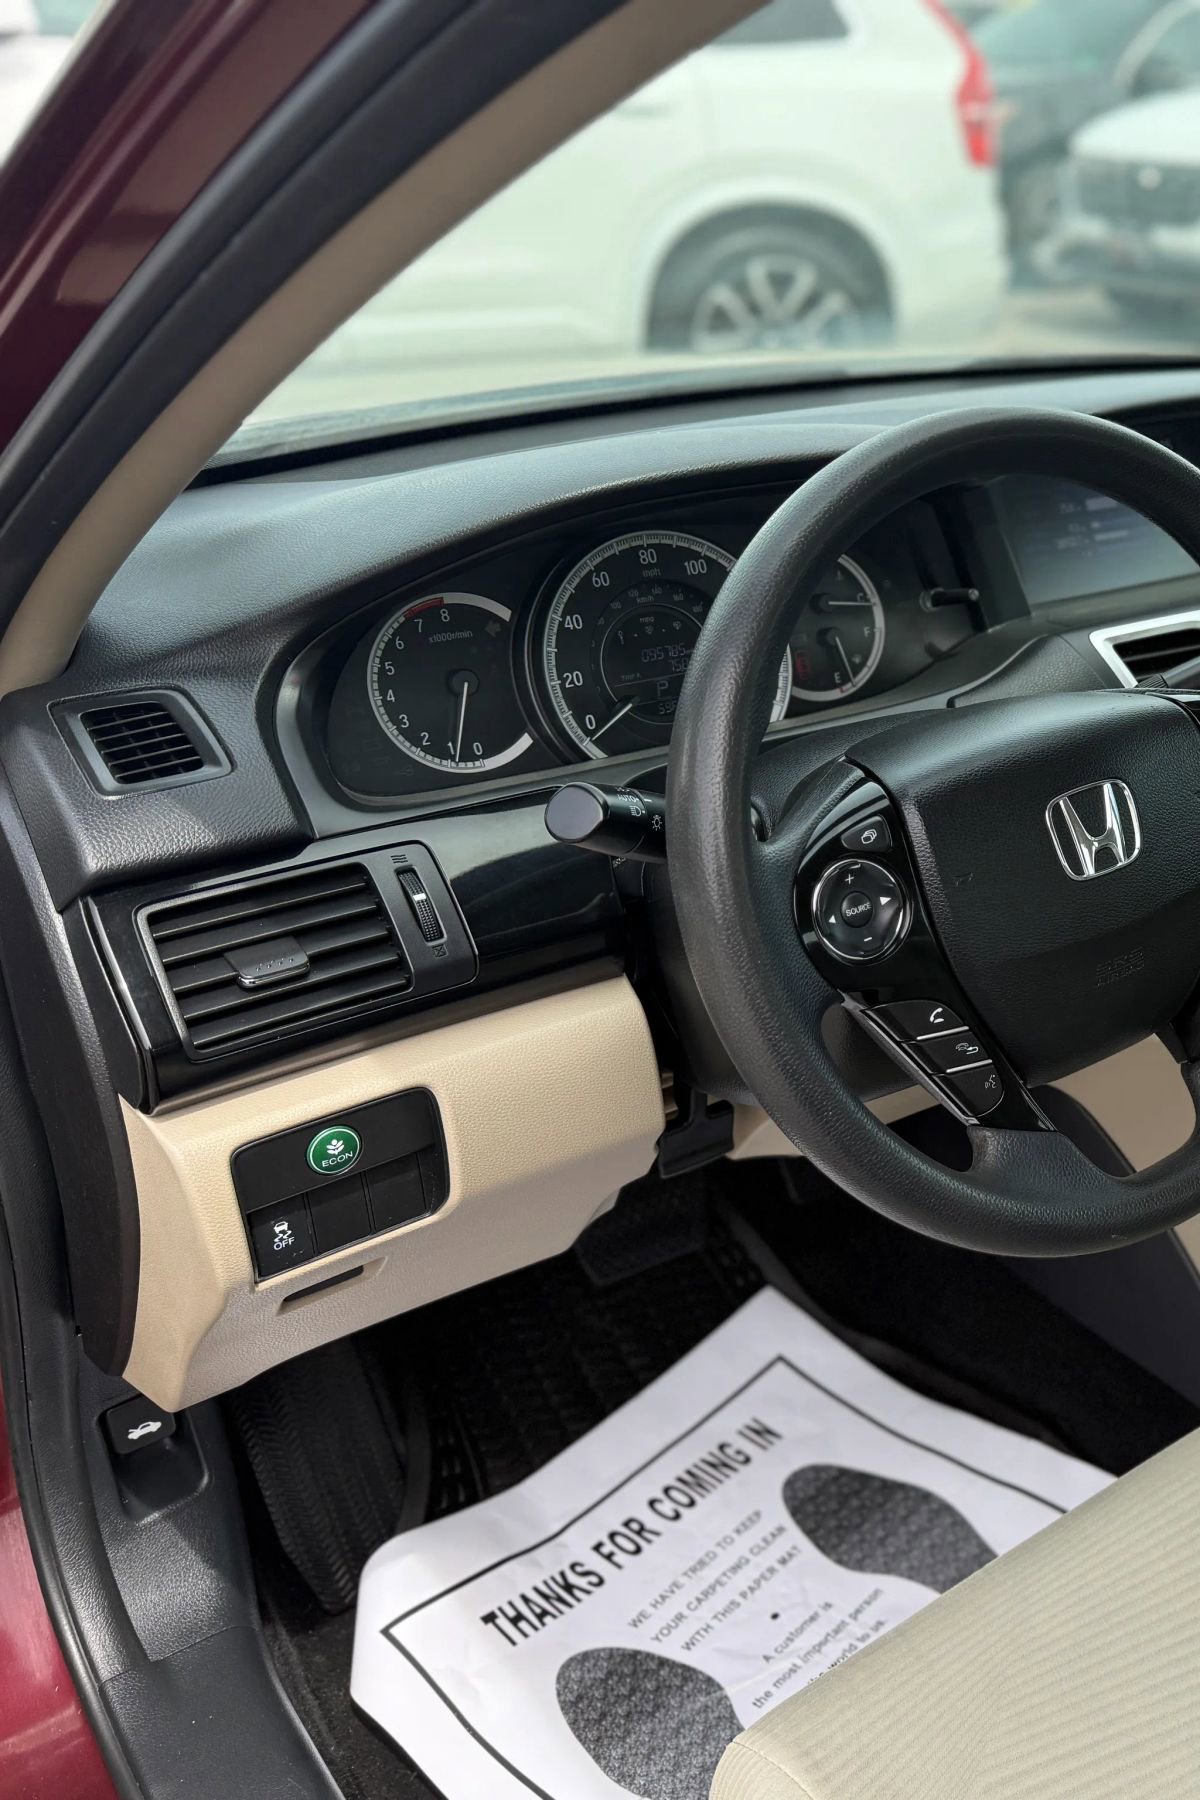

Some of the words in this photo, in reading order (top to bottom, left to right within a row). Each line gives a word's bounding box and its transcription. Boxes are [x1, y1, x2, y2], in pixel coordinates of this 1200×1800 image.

[638, 549, 657, 565] 80
[642, 568, 661, 578] mph
[684, 559, 707, 575] 100
[592, 571, 610, 588] 60
[440, 609, 450, 622] 8
[564, 614, 583, 631] 40
[414, 619, 423, 633] 7
[864, 626, 871, 637] F
[396, 636, 404, 649] 6
[385, 662, 395, 675] 5
[564, 670, 583, 688] 20
[834, 672, 842, 683] E
[387, 689, 395, 702] 4
[657, 681, 668, 697] P
[400, 714, 409, 728] 3
[584, 714, 596, 730] 0
[420, 732, 431, 745] 2
[448, 741, 455, 754] 1
[473, 742, 483, 755] 0
[846, 902, 872, 917] SOURCE
[322, 1151, 353, 1167] ECON
[273, 1236, 295, 1250] OFF
[480, 1561, 606, 1647] THANKS
[591, 1517, 663, 1570] FOR
[647, 1441, 752, 1522] COMING
[736, 1417, 783, 1451] IN
[627, 1609, 652, 1630] WE
[650, 1580, 685, 1610] HAVE
[681, 1550, 718, 1580] TRIED
[715, 1535, 735, 1551] TO
[733, 1509, 763, 1536] KEEP
[650, 1611, 688, 1644] YOUR
[686, 1556, 750, 1612] CARPETING
[749, 1524, 787, 1556] CLEAN
[681, 1623, 715, 1652] WITH
[711, 1599, 741, 1624] THIS
[739, 1566, 779, 1600] PAPER
[761, 1654, 775, 1664] A
[774, 1611, 820, 1655] customer
[819, 1601, 833, 1612] is
[752, 1690, 774, 1709] the
[772, 1663, 802, 1689] most
[798, 1620, 850, 1664] important
[848, 1588, 883, 1621] person
